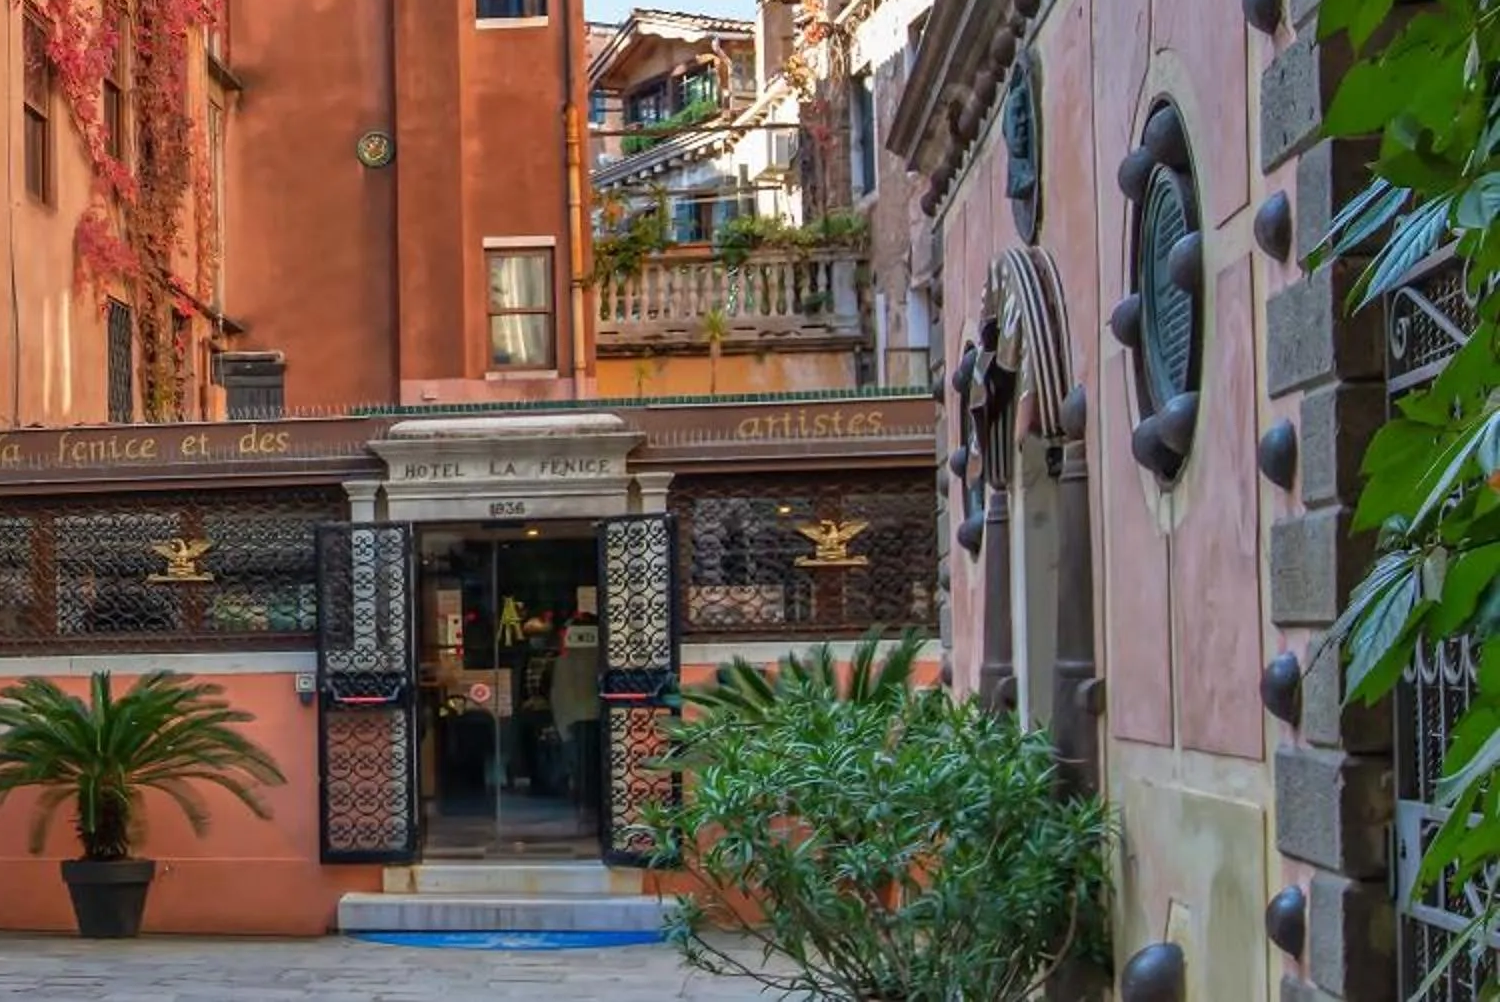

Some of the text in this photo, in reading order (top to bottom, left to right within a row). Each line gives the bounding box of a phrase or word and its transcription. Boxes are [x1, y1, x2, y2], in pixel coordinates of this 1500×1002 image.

[181, 433, 209, 455] et
[240, 424, 290, 453] des
[738, 409, 884, 438] artistes
[405, 459, 610, 478] HOTEL LA FENICE
